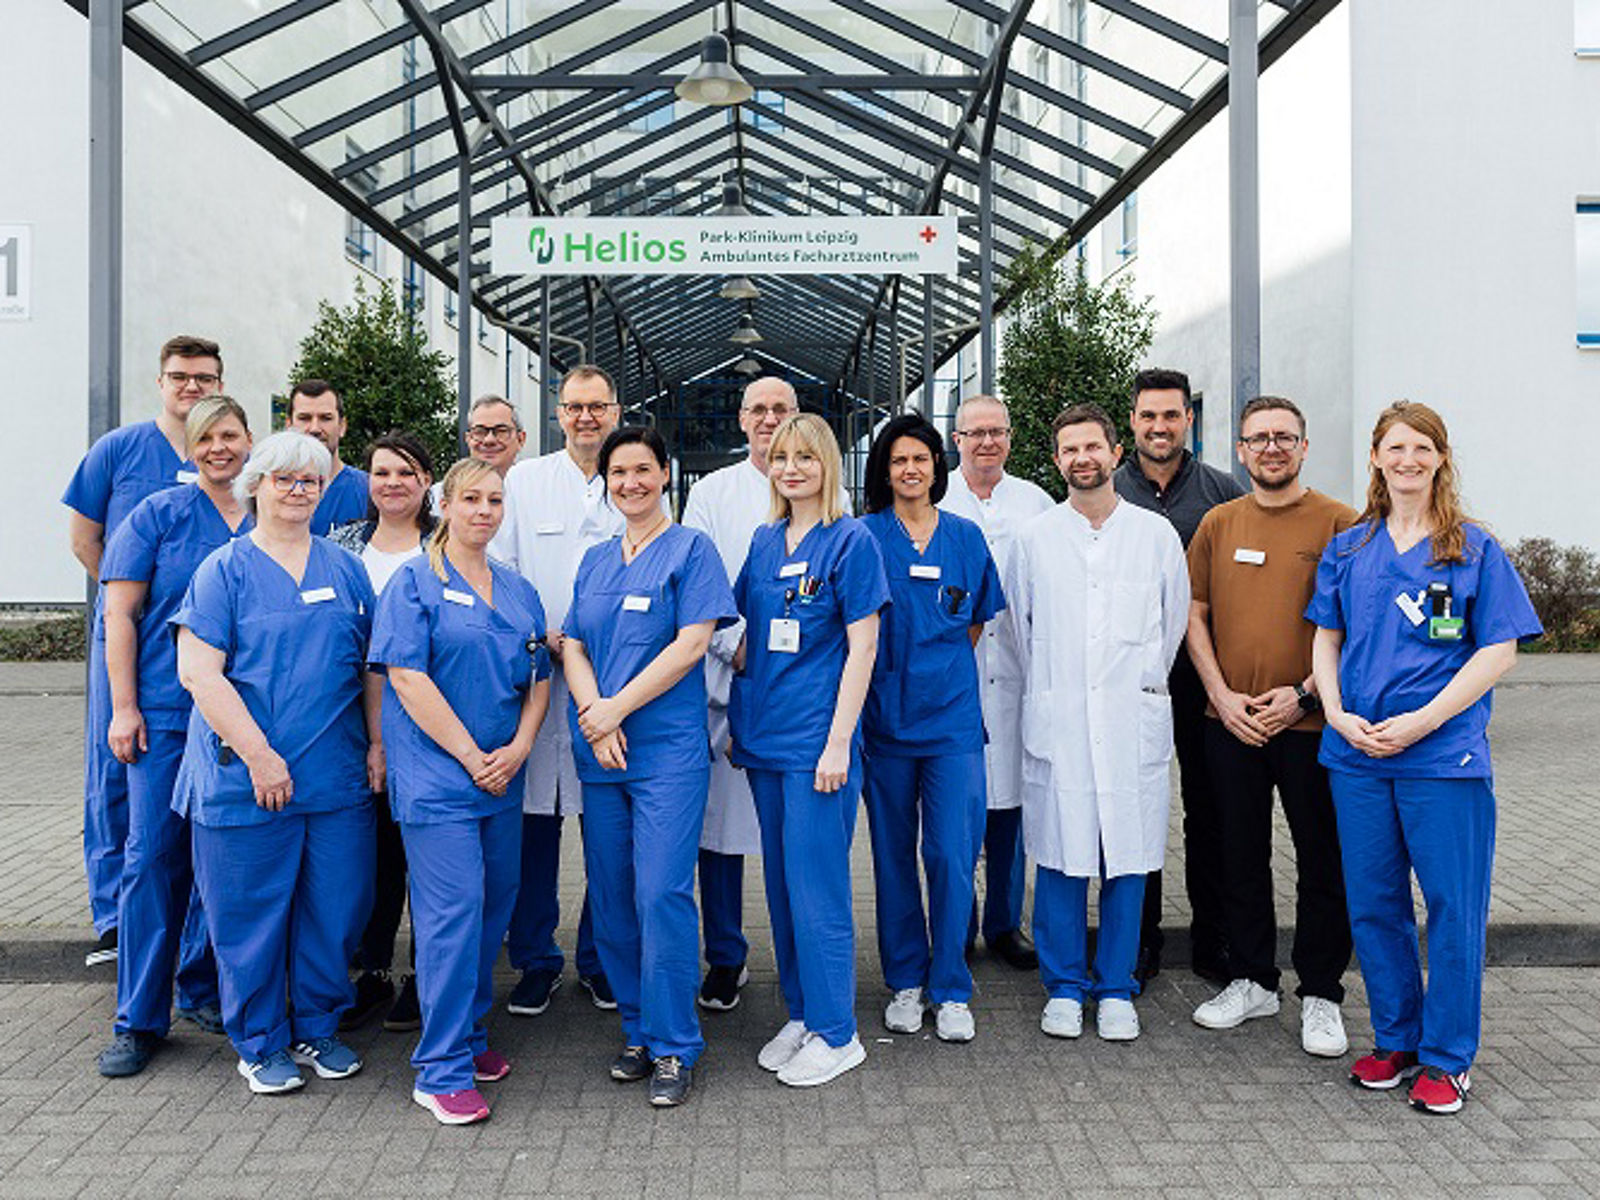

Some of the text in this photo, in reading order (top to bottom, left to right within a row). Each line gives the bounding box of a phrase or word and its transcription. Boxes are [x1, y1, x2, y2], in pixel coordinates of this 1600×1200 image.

[564, 231, 687, 262] Helios
[700, 230, 859, 245] Park-Klinikum Leipzig
[0, 237, 18, 296] 1
[700, 249, 919, 263] Ambulantes Facharztzentrum
